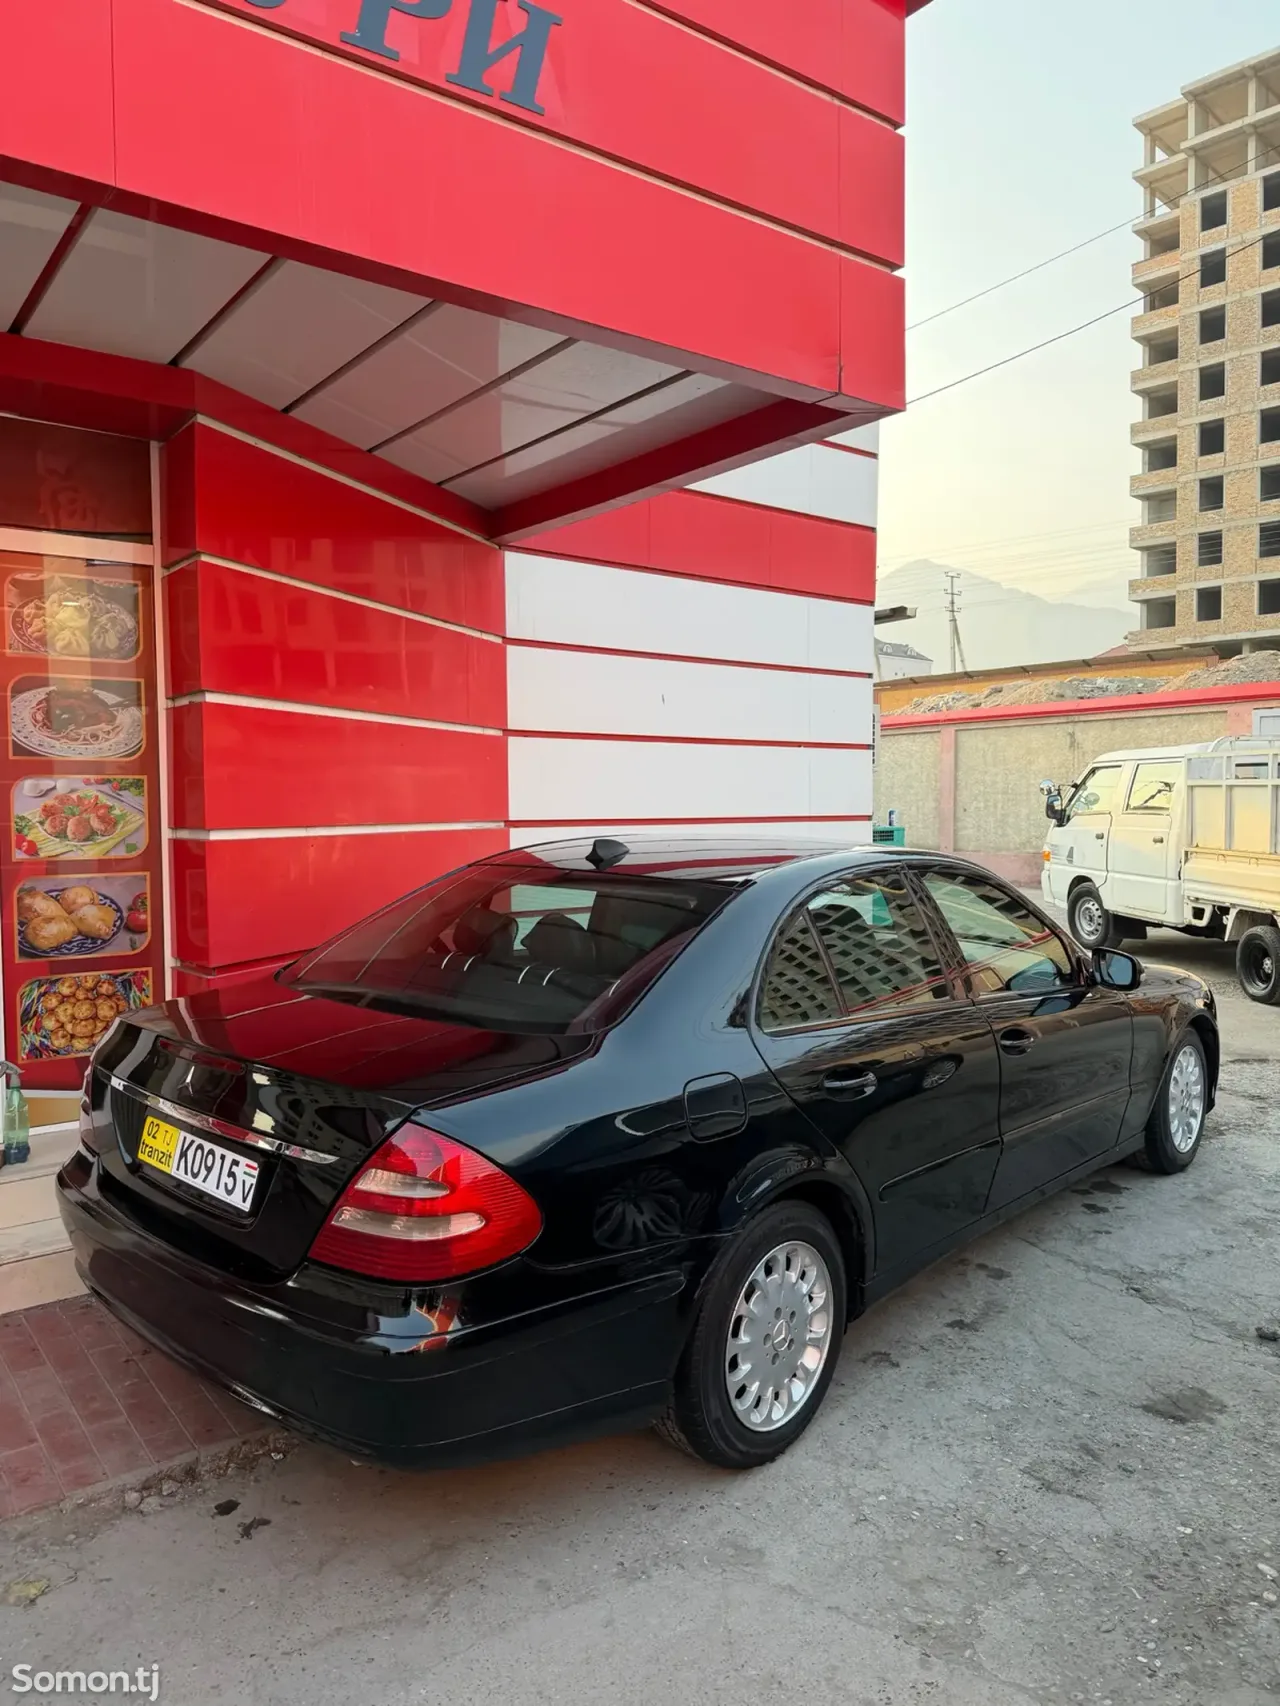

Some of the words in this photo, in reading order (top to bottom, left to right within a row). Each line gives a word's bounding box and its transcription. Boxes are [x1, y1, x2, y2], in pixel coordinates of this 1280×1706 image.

[245, 0, 562, 116] РИ
[147, 1121, 160, 1140] 02
[162, 1130, 174, 1146] TJ
[140, 1140, 173, 1168] tranzit
